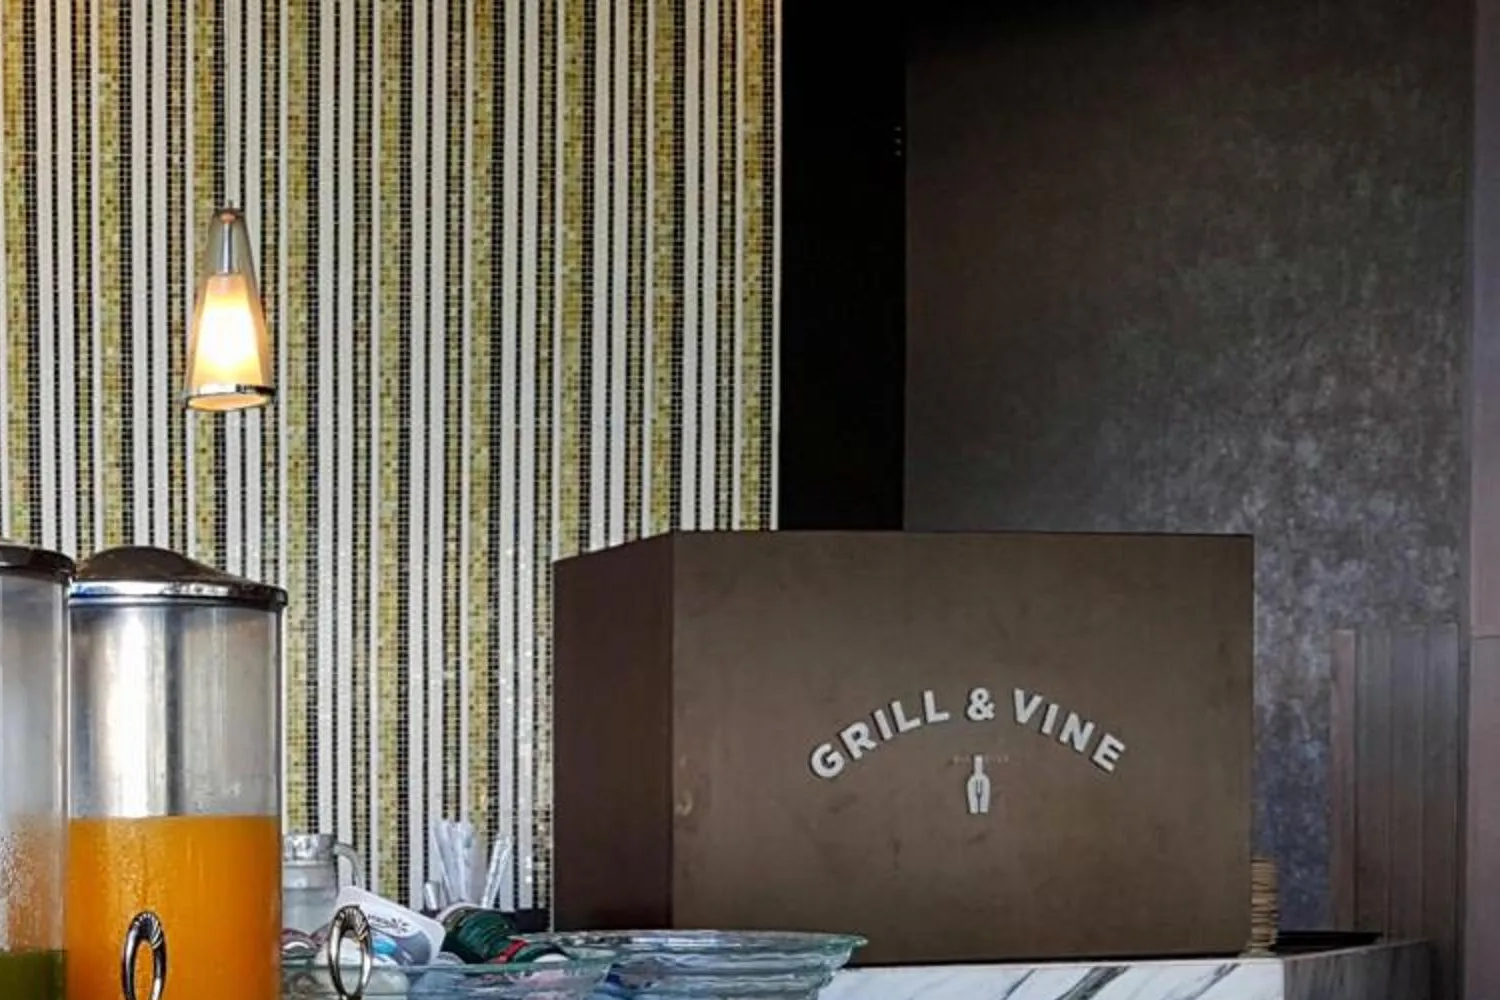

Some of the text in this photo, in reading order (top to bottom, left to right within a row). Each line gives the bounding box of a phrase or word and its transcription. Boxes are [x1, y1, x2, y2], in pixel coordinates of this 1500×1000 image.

[809, 687, 1126, 778] GRILL & VINE
